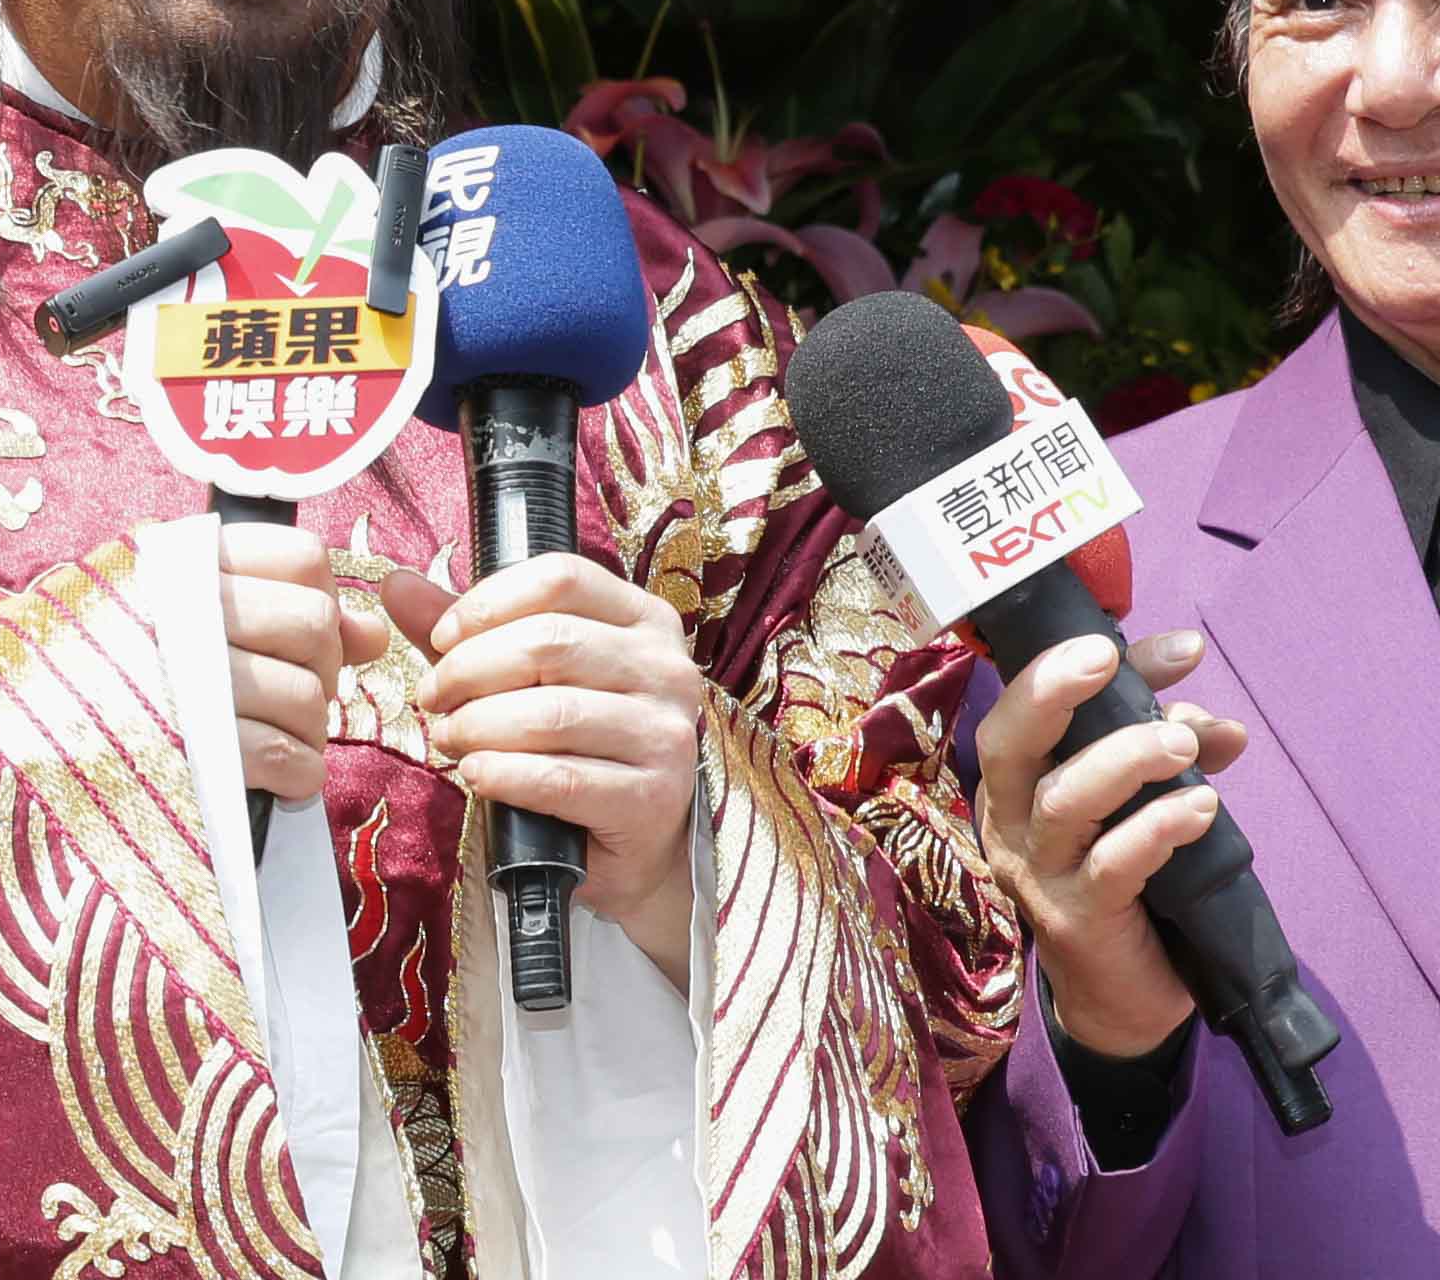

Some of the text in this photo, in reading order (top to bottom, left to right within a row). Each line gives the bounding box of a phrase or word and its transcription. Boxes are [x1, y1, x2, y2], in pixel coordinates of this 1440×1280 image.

[420, 145, 499, 293] 民視
[202, 305, 362, 370] 蘋果
[200, 376, 358, 442] 娛樂
[936, 421, 1096, 546] 壹新聞
